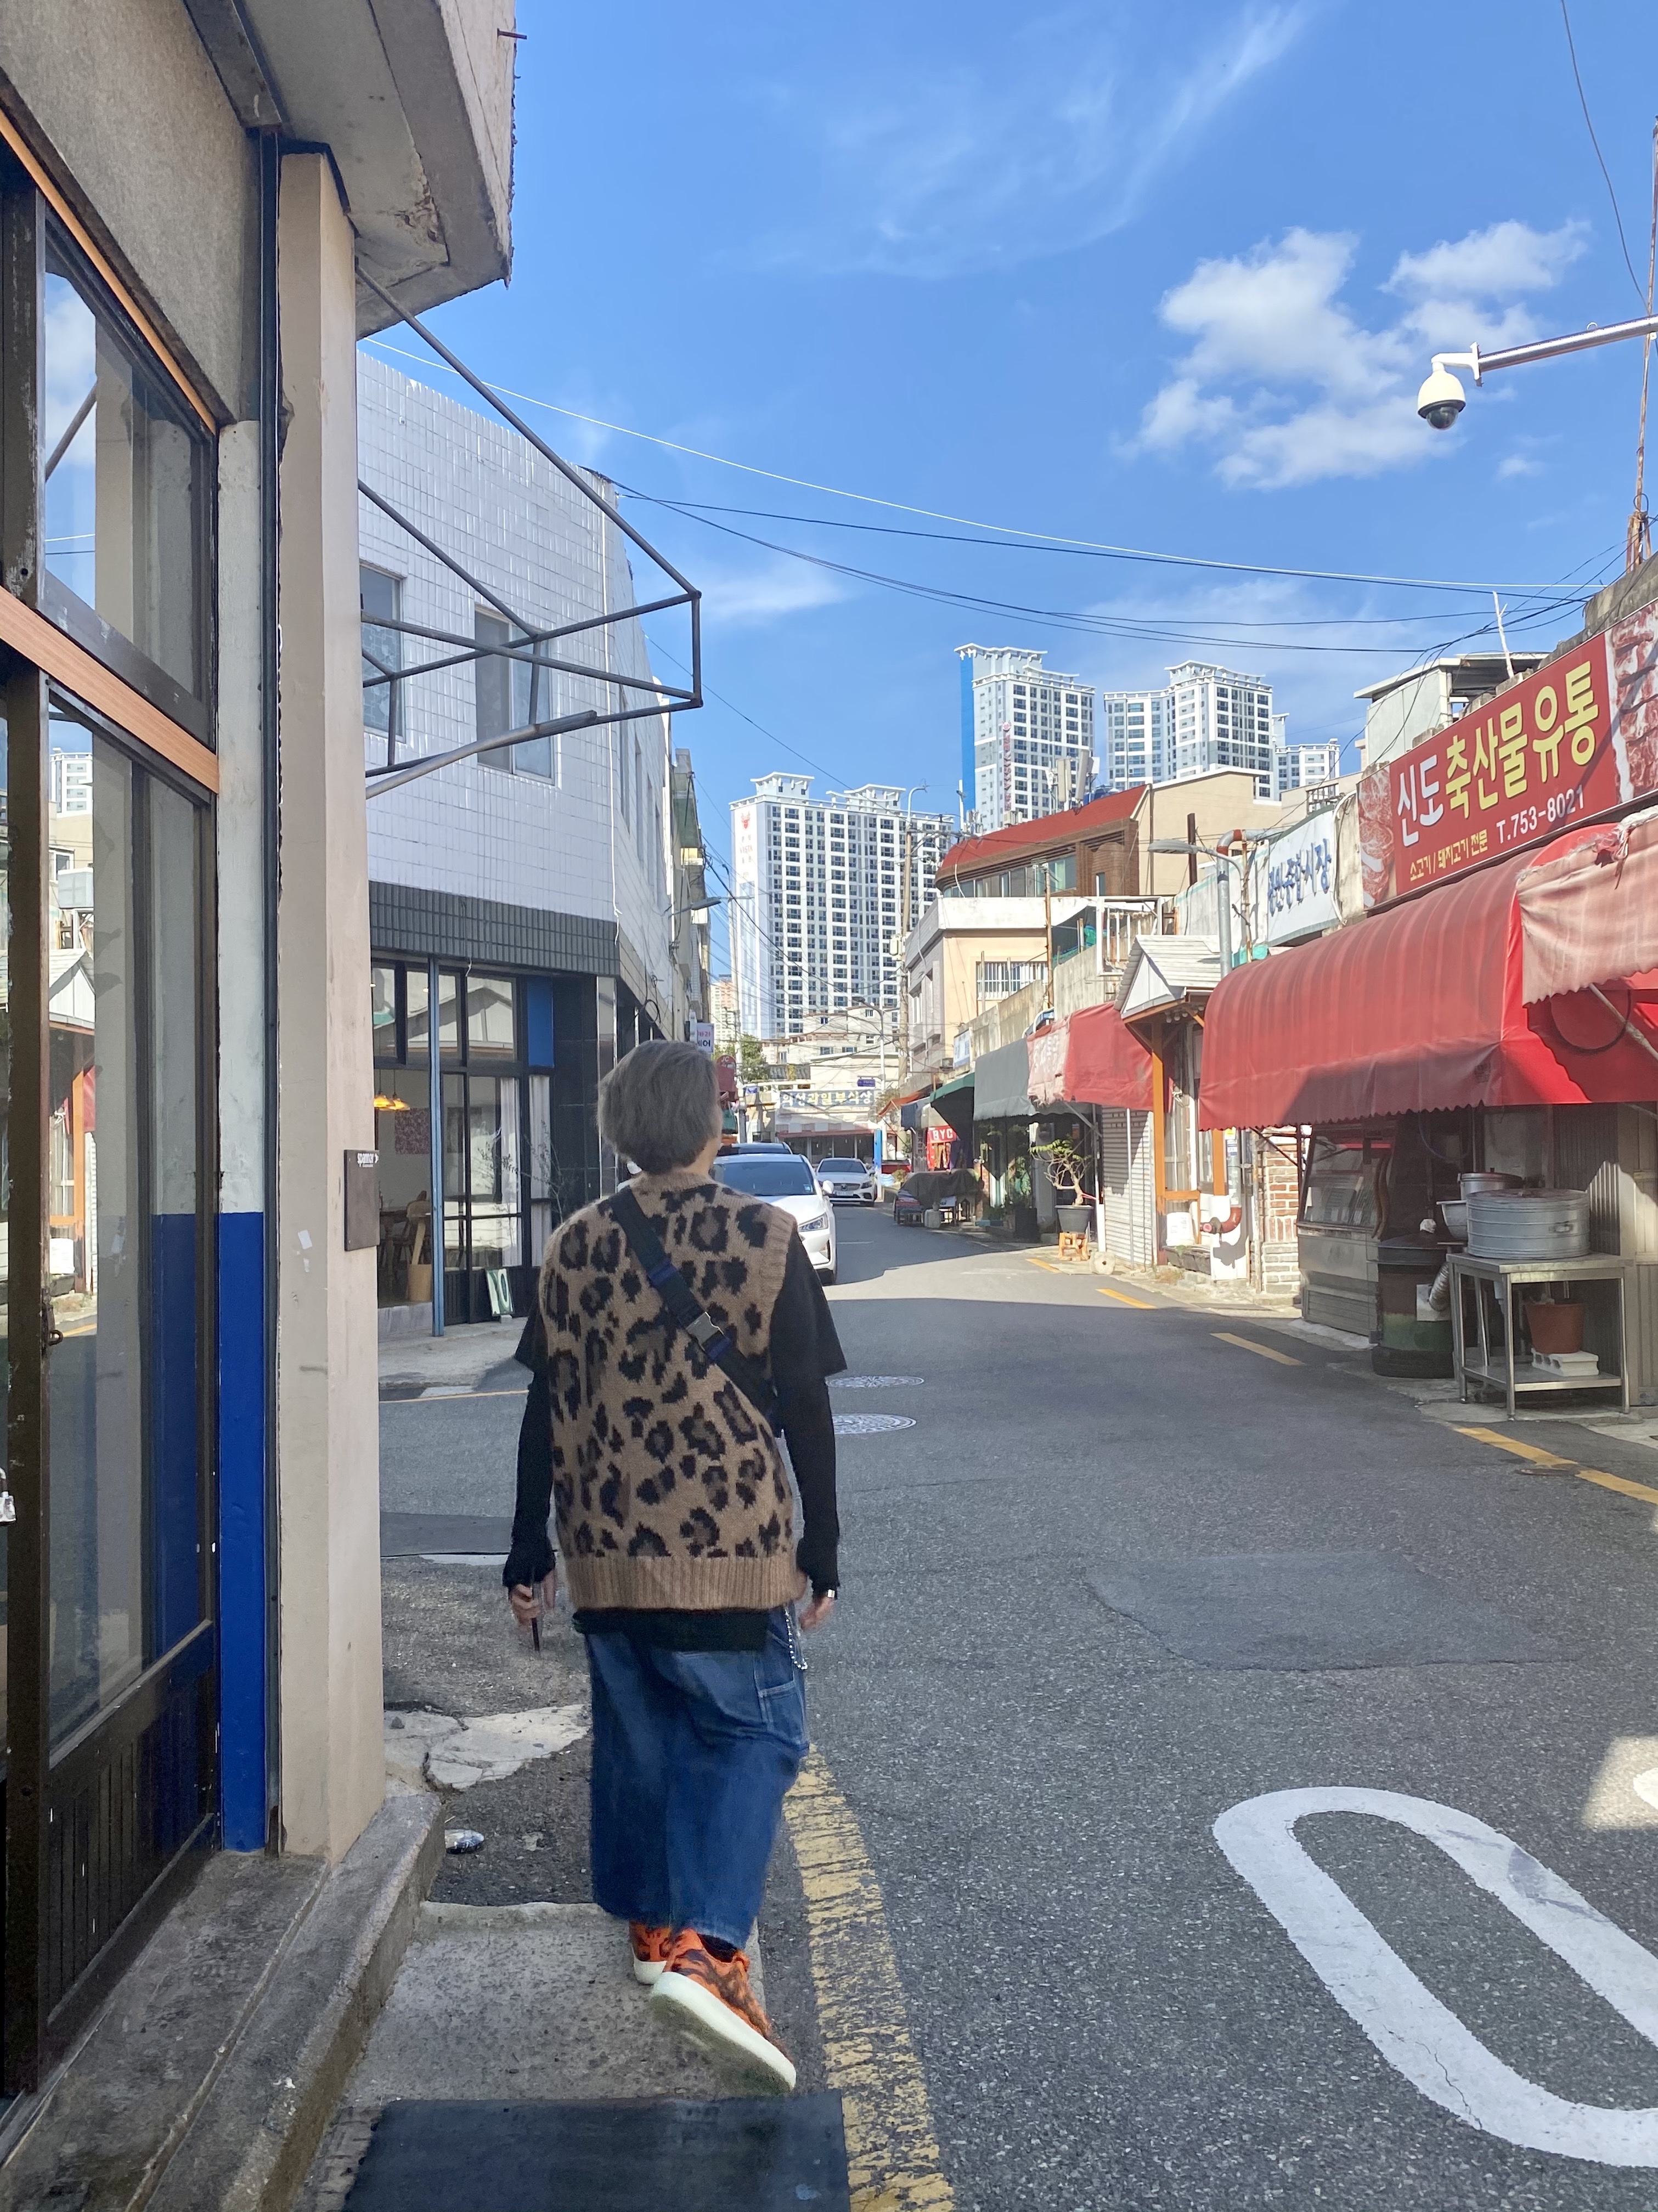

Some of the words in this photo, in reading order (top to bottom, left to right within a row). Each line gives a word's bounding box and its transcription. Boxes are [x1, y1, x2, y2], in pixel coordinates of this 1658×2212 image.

[1496, 785, 1584, 844] T.753-8021
[1470, 829, 1488, 856] 전문
[933, 1128, 953, 1141] BYC
